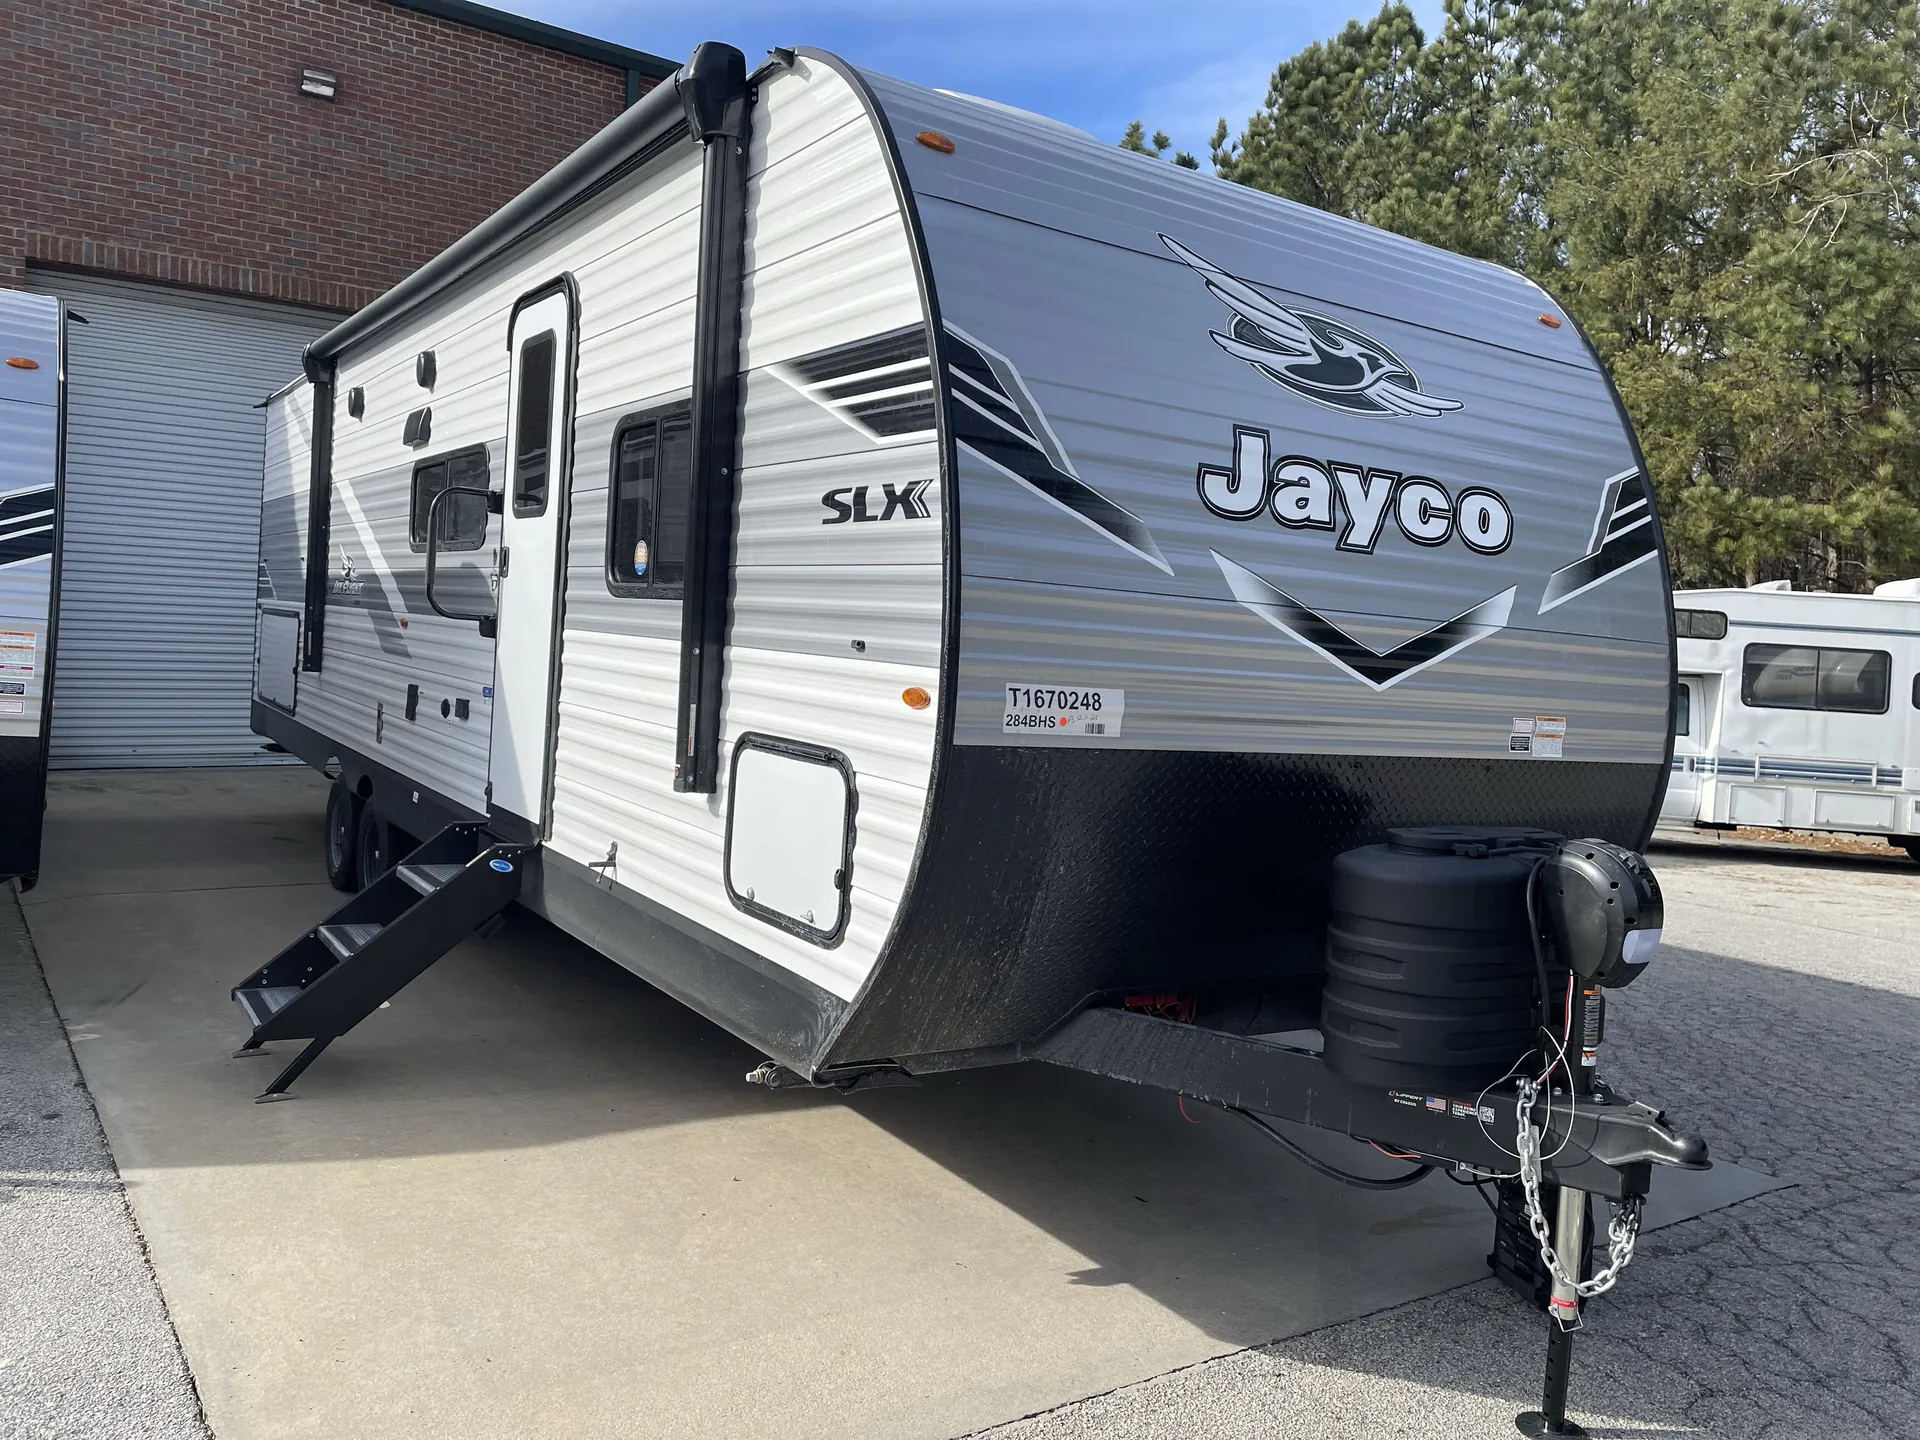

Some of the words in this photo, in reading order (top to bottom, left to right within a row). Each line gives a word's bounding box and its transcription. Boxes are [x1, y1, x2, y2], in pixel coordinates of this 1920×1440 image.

[821, 479, 934, 525] SLX
[1196, 423, 1514, 556] Jayco
[1008, 687, 1102, 711] T1670248
[1005, 714, 1056, 729] 284BHS
